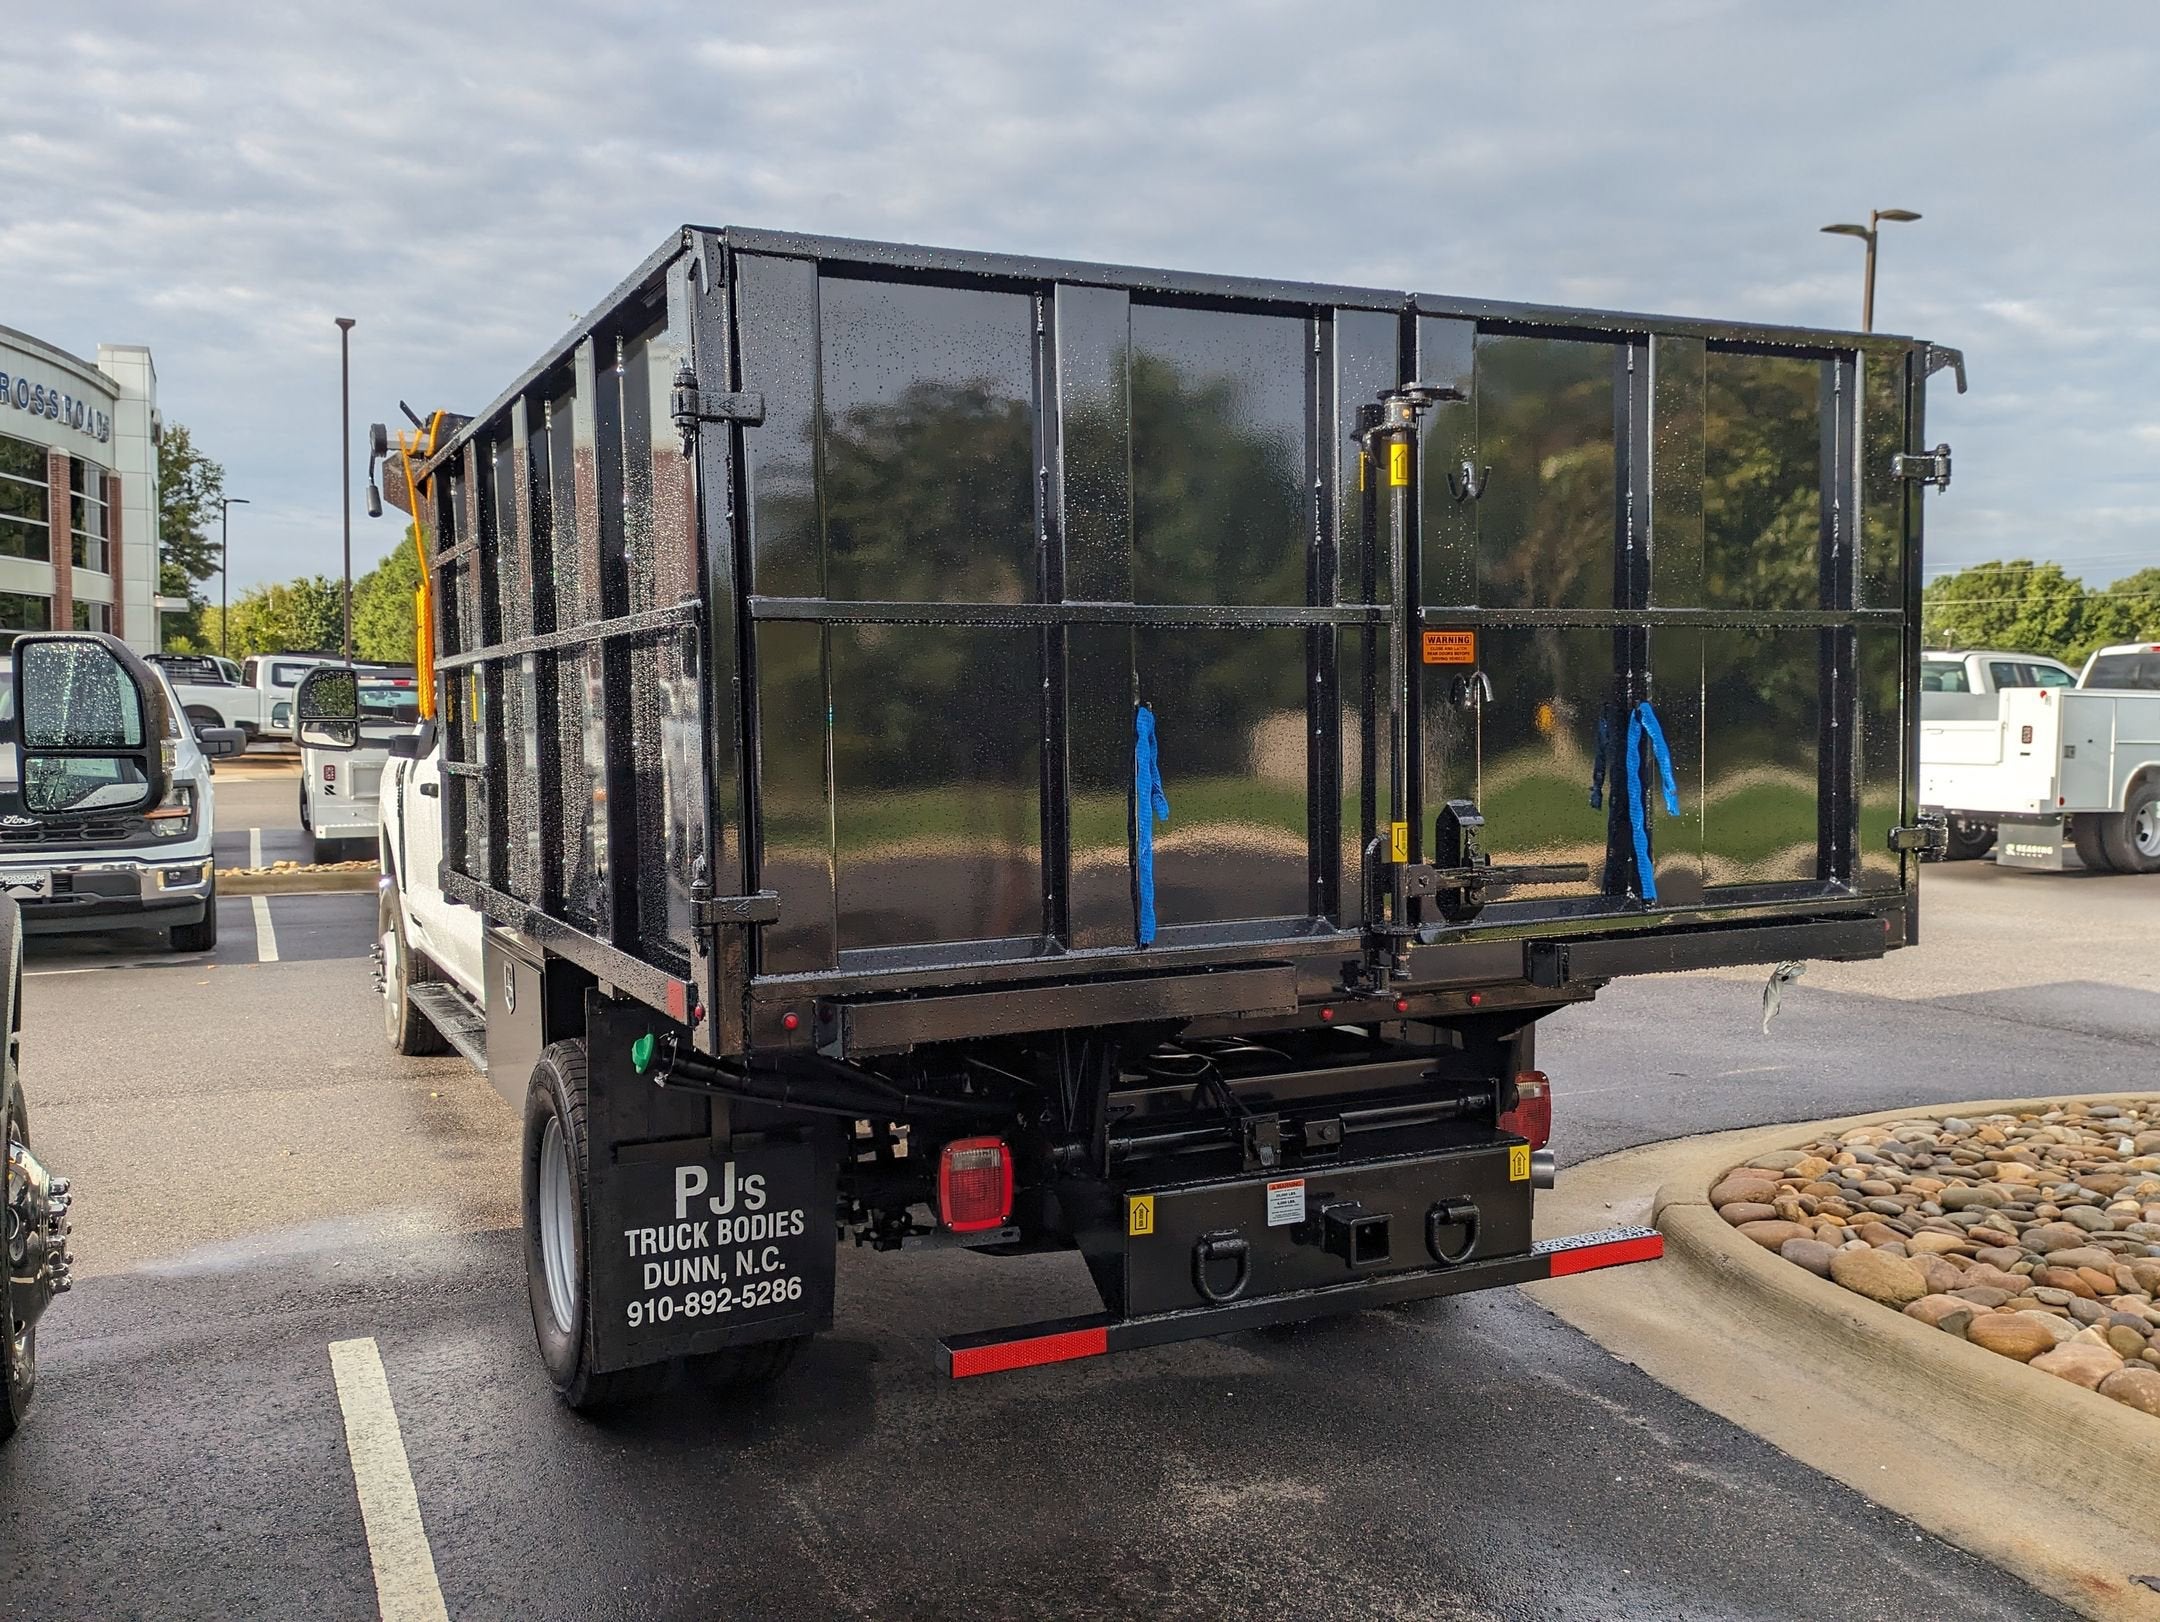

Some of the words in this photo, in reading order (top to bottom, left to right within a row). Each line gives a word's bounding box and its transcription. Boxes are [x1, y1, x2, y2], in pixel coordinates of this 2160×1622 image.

[1427, 636, 1470, 644] WARNING
[624, 1220, 710, 1257] TRUCK
[717, 1208, 805, 1246] BODIES
[643, 1253, 727, 1291] DUNN,
[736, 1245, 786, 1277] N.C.
[626, 1276, 803, 1328] 910-892-5286
